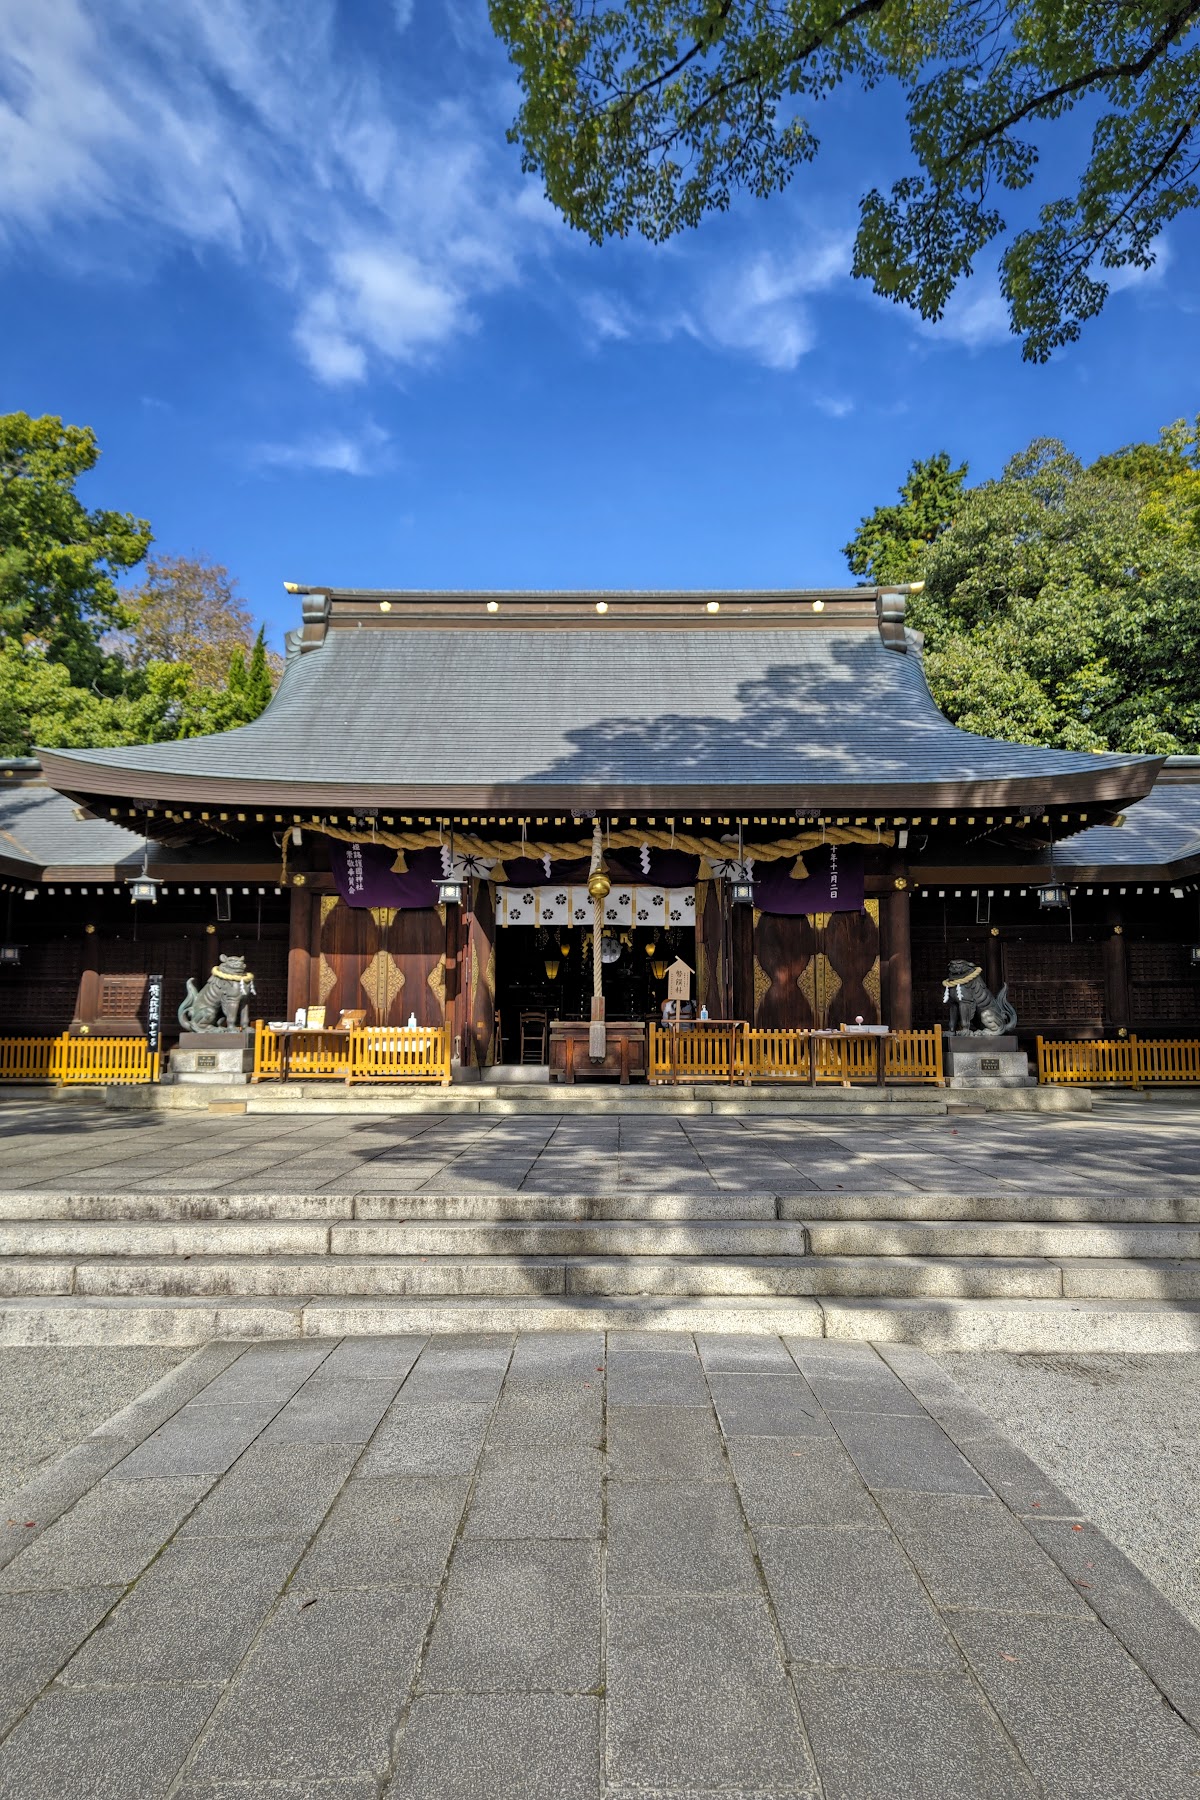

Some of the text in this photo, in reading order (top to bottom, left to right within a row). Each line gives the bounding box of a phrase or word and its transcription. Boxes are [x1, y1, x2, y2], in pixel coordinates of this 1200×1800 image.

[830, 845, 838, 898] 十年十一月二日
